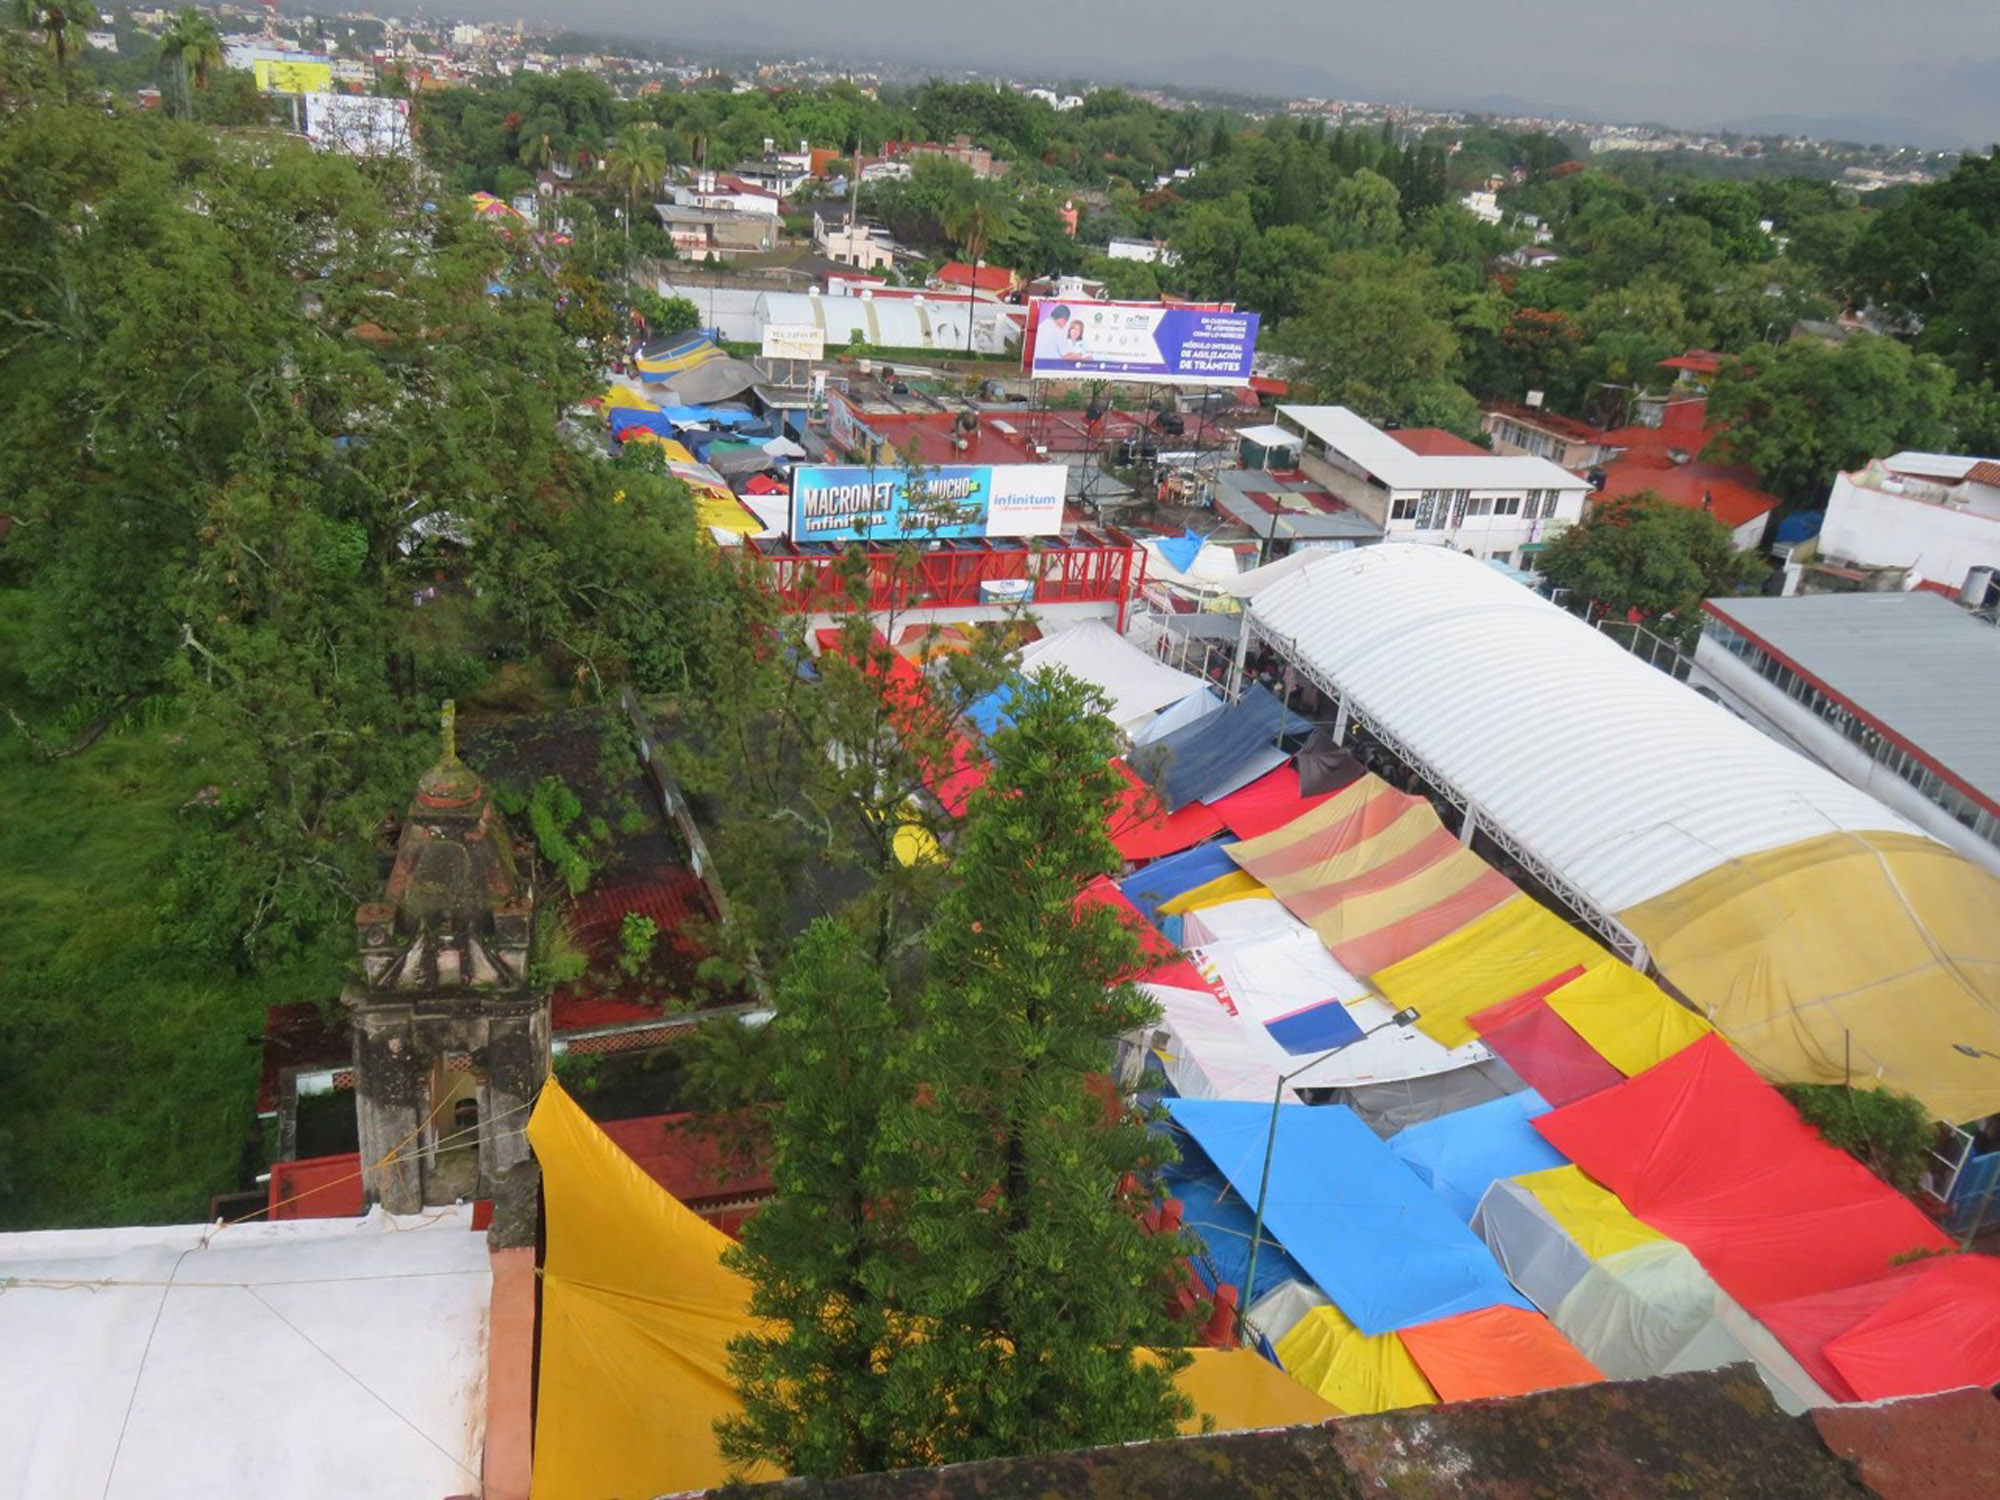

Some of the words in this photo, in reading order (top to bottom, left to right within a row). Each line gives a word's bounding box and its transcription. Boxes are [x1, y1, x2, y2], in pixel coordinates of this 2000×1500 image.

[1182, 340, 1211, 350] MÓDULO
[1212, 343, 1243, 351] INTEGRAL
[1180, 350, 1192, 358] DE
[1192, 349, 1243, 361] AGILIZACIÓN
[1179, 360, 1192, 370] DE
[1194, 358, 1241, 371] TRÁMITES
[928, 477, 971, 500] MUCHO
[803, 483, 894, 518] MACRONET
[993, 493, 1057, 506] infinitum
